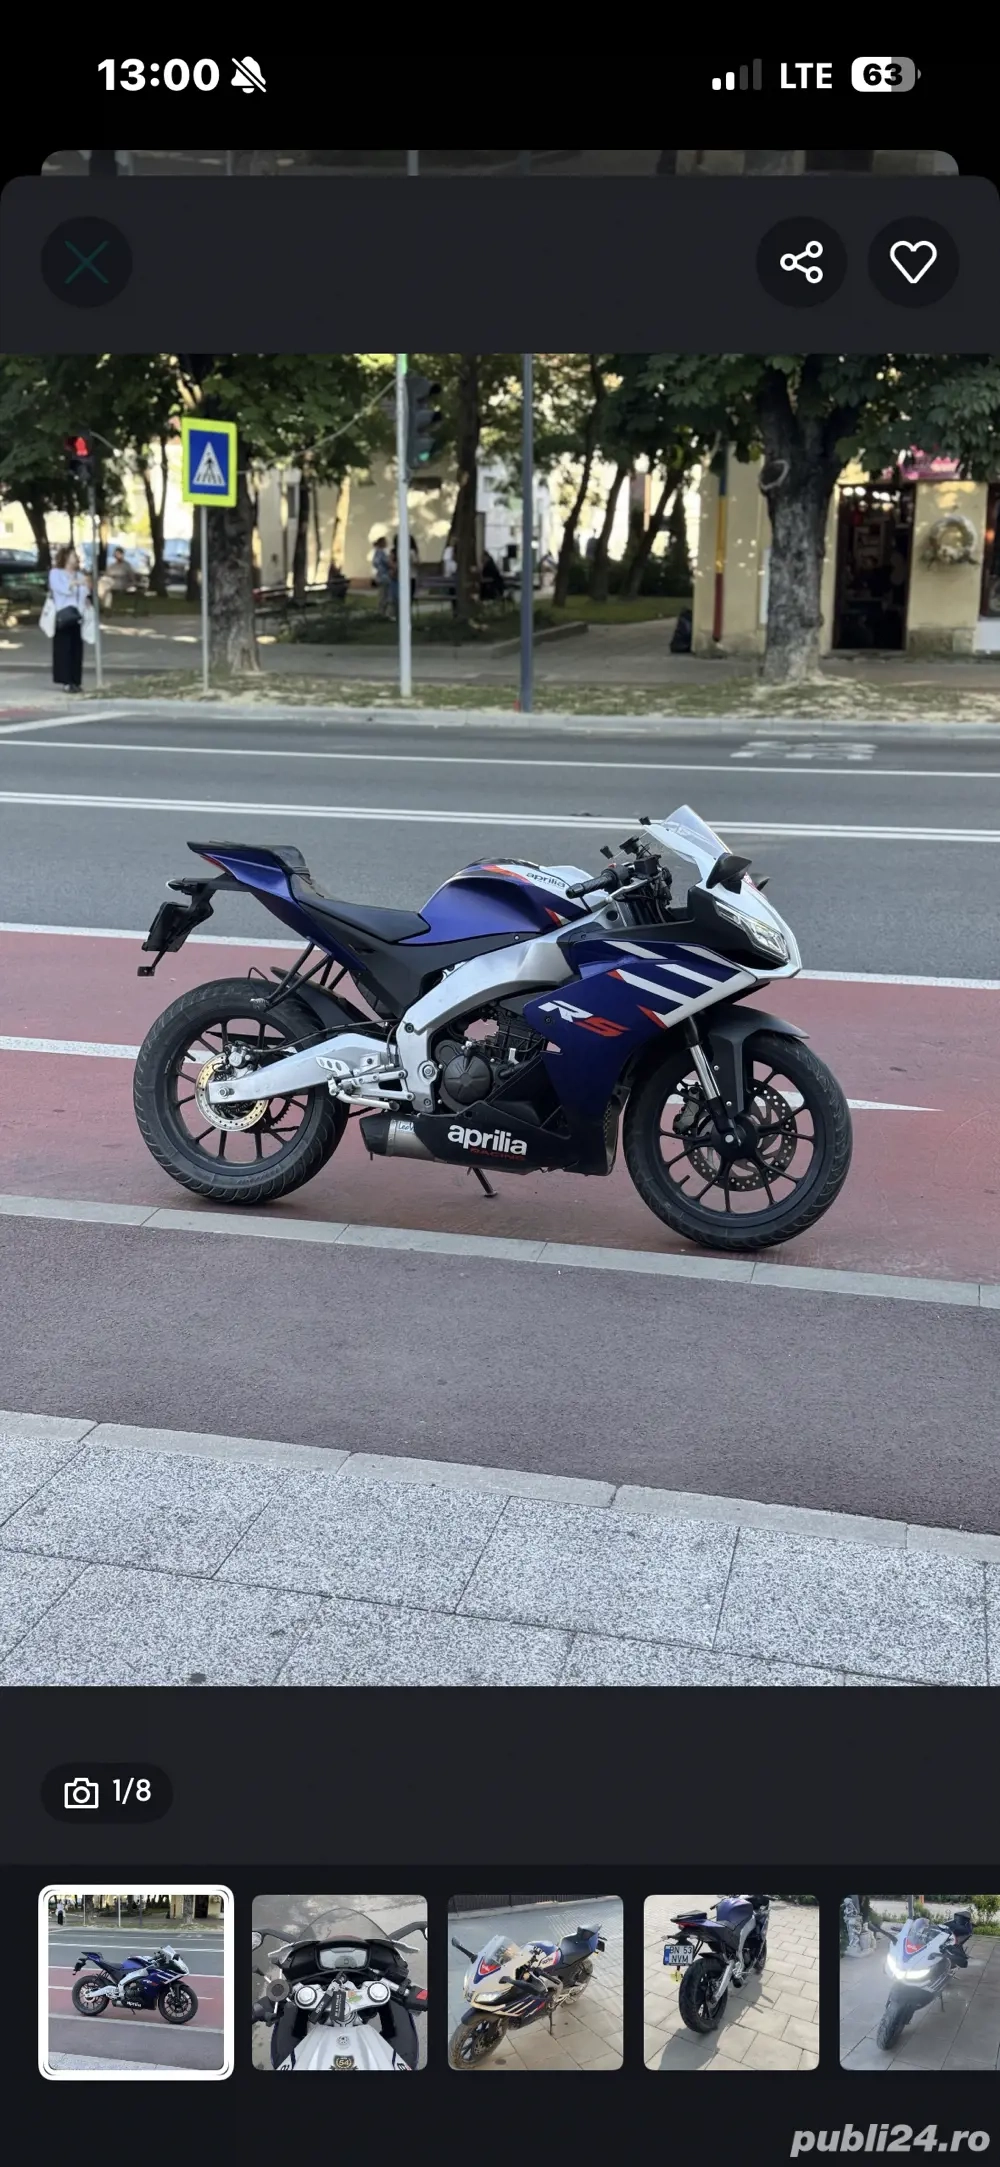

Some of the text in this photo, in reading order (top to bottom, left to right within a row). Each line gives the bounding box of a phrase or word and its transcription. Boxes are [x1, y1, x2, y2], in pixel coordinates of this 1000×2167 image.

[98, 58, 219, 91] 13:00
[780, 62, 832, 89] LTE
[863, 63, 903, 86] 63
[526, 872, 566, 888] aprilia
[538, 1000, 632, 1037] RS
[447, 1124, 528, 1156] aprilia
[470, 1147, 525, 1161] RACING
[112, 1777, 152, 1805] 1/8
